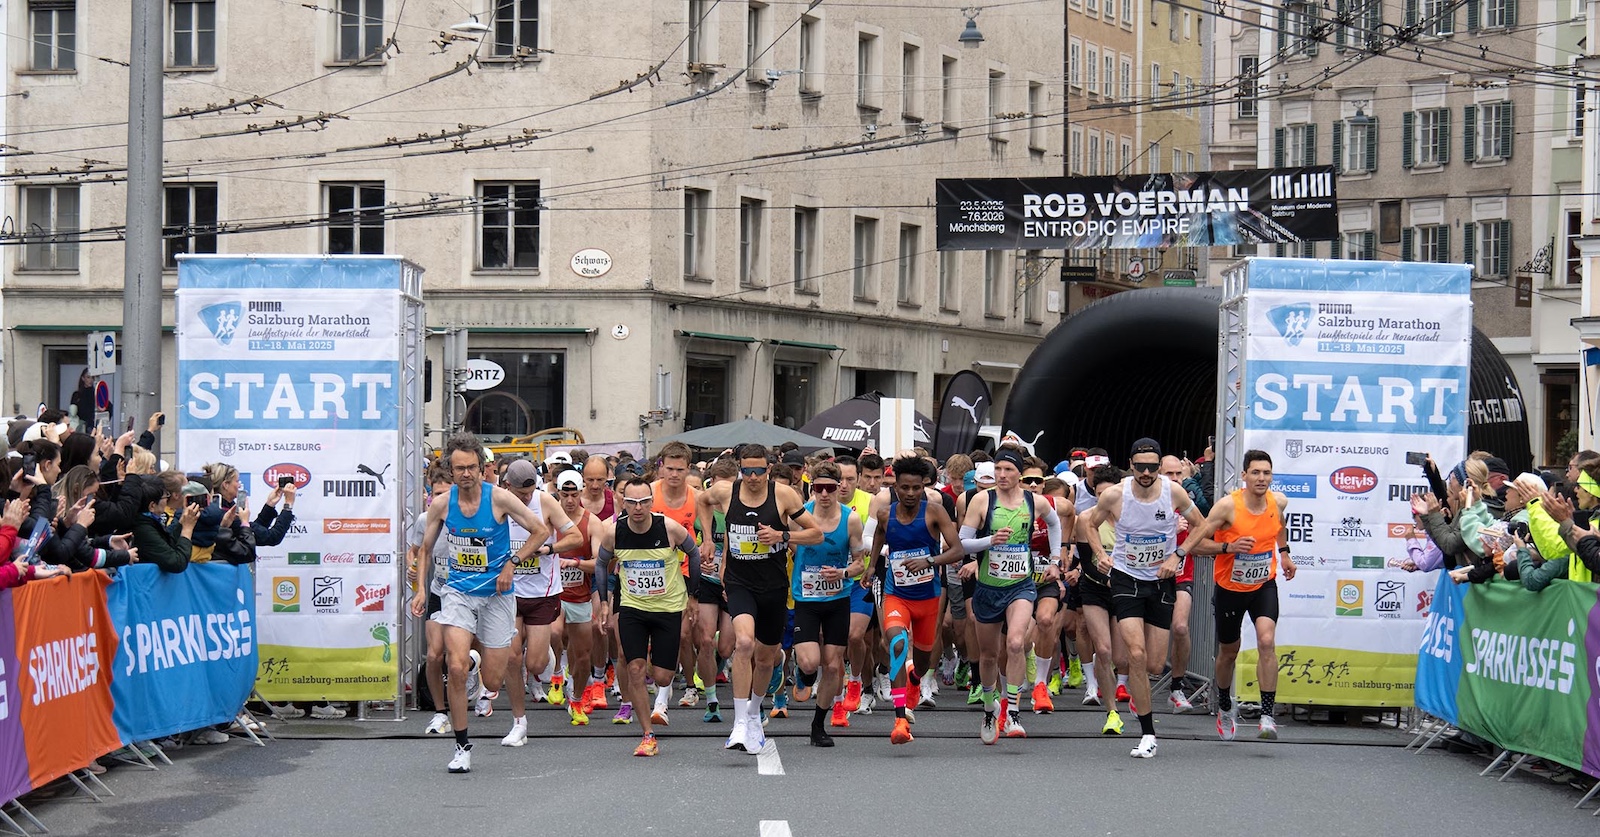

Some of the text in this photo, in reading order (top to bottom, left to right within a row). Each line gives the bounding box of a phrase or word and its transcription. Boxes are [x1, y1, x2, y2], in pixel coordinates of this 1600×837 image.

[960, 201, 1004, 210] 23.5.2025
[1023, 187, 1249, 218] ROB VOERMAN
[1271, 210, 1295, 218] Salzburg
[949, 223, 1005, 234] Mönchsberg
[1023, 218, 1190, 238] ENTROPIC EMPIRE
[575, 255, 611, 266] Schwarz-
[581, 267, 600, 275] Straße
[249, 301, 282, 312] PUMA
[1318, 303, 1352, 314] PUMA
[248, 314, 370, 327] Salzburg Marathon
[1318, 316, 1441, 330] Salzburg Marathon
[248, 327, 370, 340] Lauffestspiele der Mozartstadt
[617, 325, 623, 334] 2
[1318, 330, 1440, 342] Lauffestspiele der Mozartstadt
[288, 341, 306, 349] Mai
[309, 341, 332, 349] 2025
[1356, 344, 1376, 353] Mai
[1379, 345, 1402, 353] 2025
[465, 368, 500, 381] ÖRTZ
[189, 372, 391, 419] START
[1254, 372, 1459, 425] START
[822, 427, 862, 441] PUMA
[238, 443, 266, 451] STADT
[273, 443, 321, 451] SALZBURG
[1305, 445, 1332, 453] STADT
[1340, 446, 1389, 455] SALZBURG
[1334, 472, 1374, 489] Hervis
[323, 480, 376, 497] PUMA
[730, 523, 756, 534] PUMA
[1331, 528, 1372, 537] FESTINA
[448, 534, 471, 546] PUMA
[752, 543, 758, 553] 2
[461, 554, 482, 565] 356
[1138, 550, 1164, 562] 2793
[1001, 560, 1026, 572] 2804
[1245, 566, 1269, 578] 6076
[280, 584, 293, 592] Bio
[637, 576, 664, 589] 5343
[355, 585, 390, 607] Stiegl
[1343, 587, 1357, 596] Bio
[1466, 628, 1560, 690] SPARKASSE
[292, 675, 390, 685] salzburg-marathon.at
